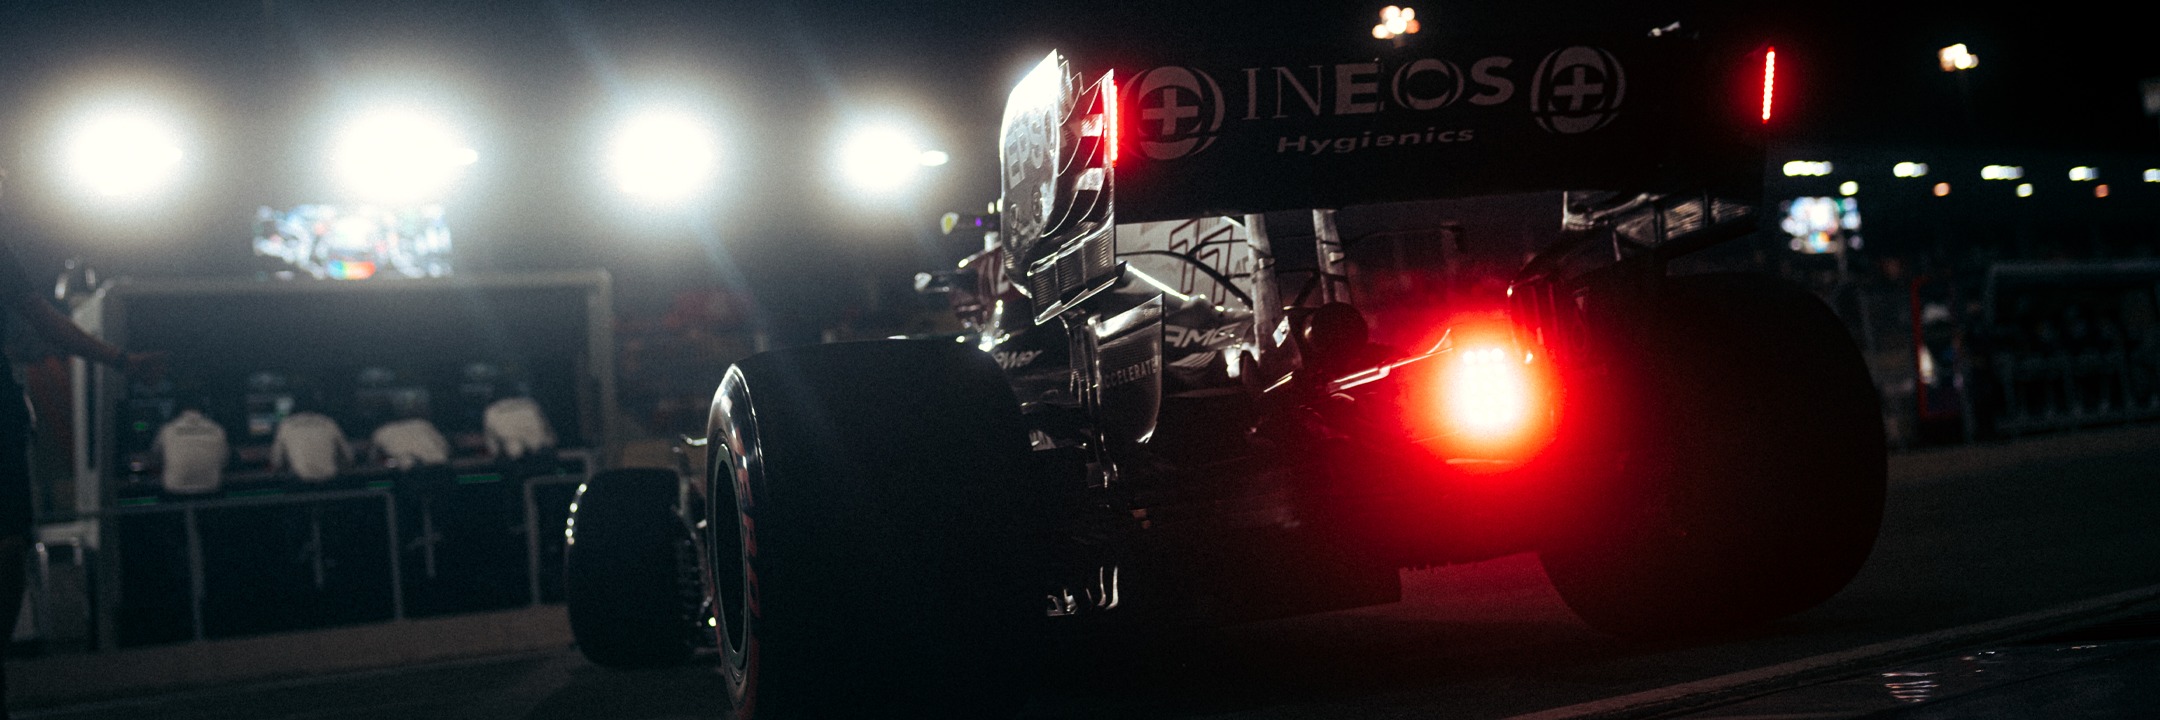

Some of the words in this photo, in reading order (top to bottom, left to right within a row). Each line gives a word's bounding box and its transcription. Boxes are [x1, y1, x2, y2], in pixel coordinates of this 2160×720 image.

[1241, 56, 1514, 121] INEOS
[1277, 127, 1475, 154] Hygienics
[1100, 358, 1158, 388] CCELERATE
